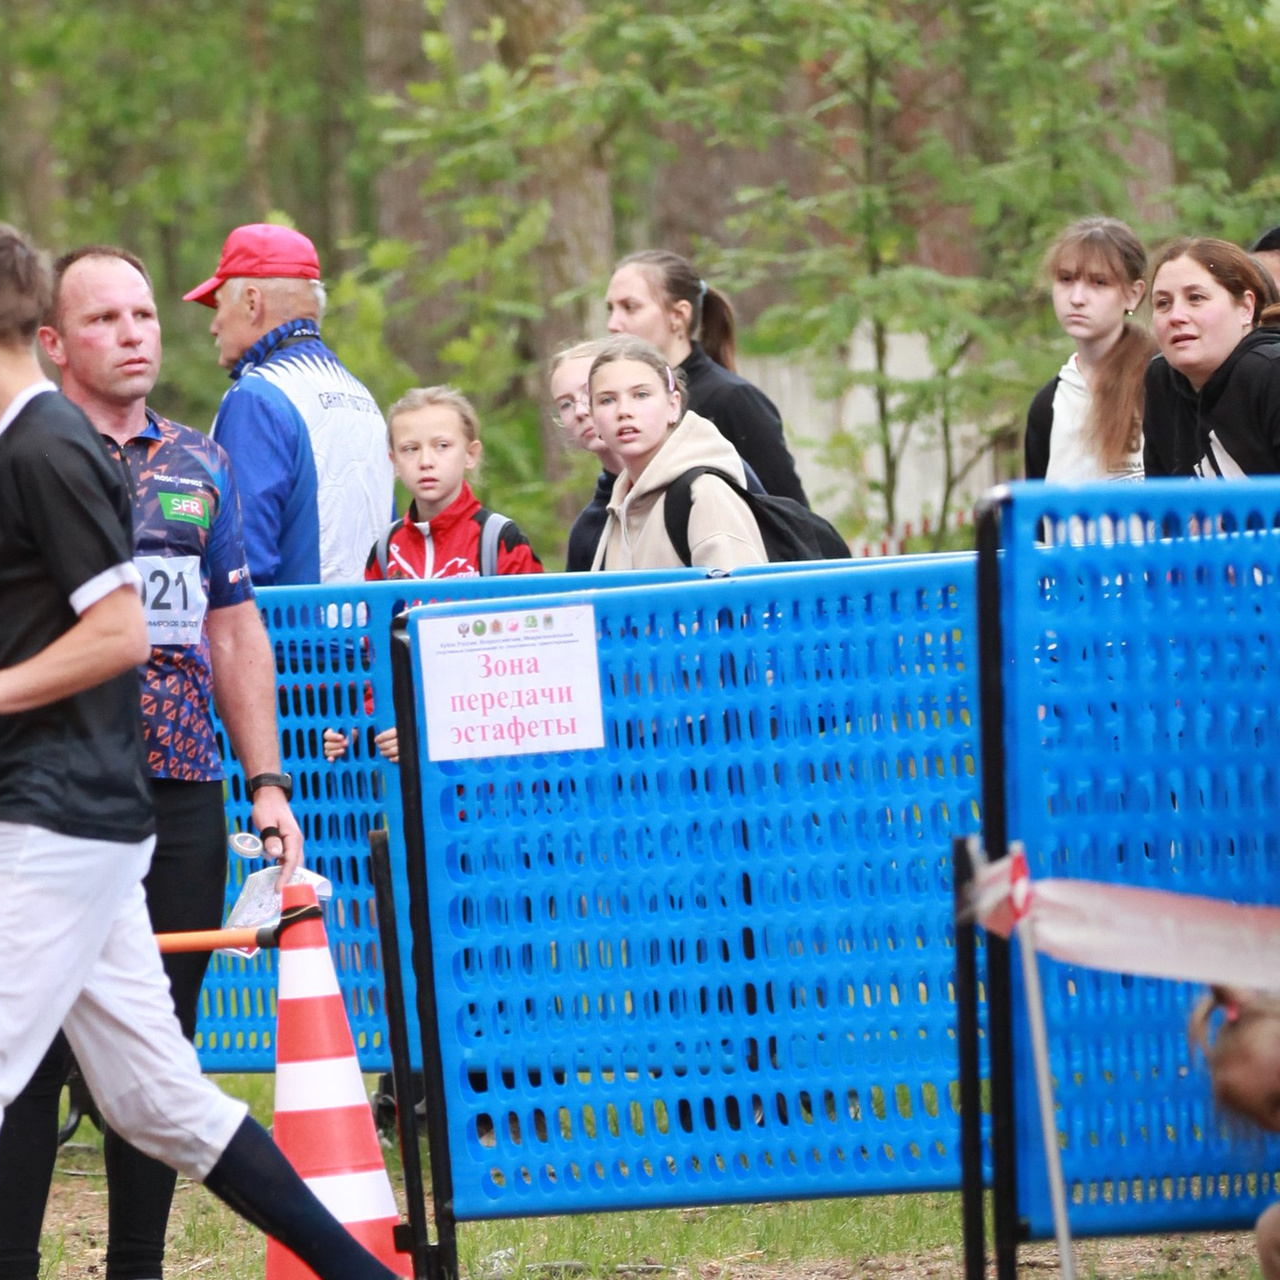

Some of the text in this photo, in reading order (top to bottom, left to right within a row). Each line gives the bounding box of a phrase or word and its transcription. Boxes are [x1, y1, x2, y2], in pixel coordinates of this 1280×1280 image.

[171, 498, 202, 516] SFR
[141, 569, 189, 611] 21
[477, 653, 540, 679] Зона
[450, 685, 573, 717] передачи
[450, 715, 577, 747] эстафеты
